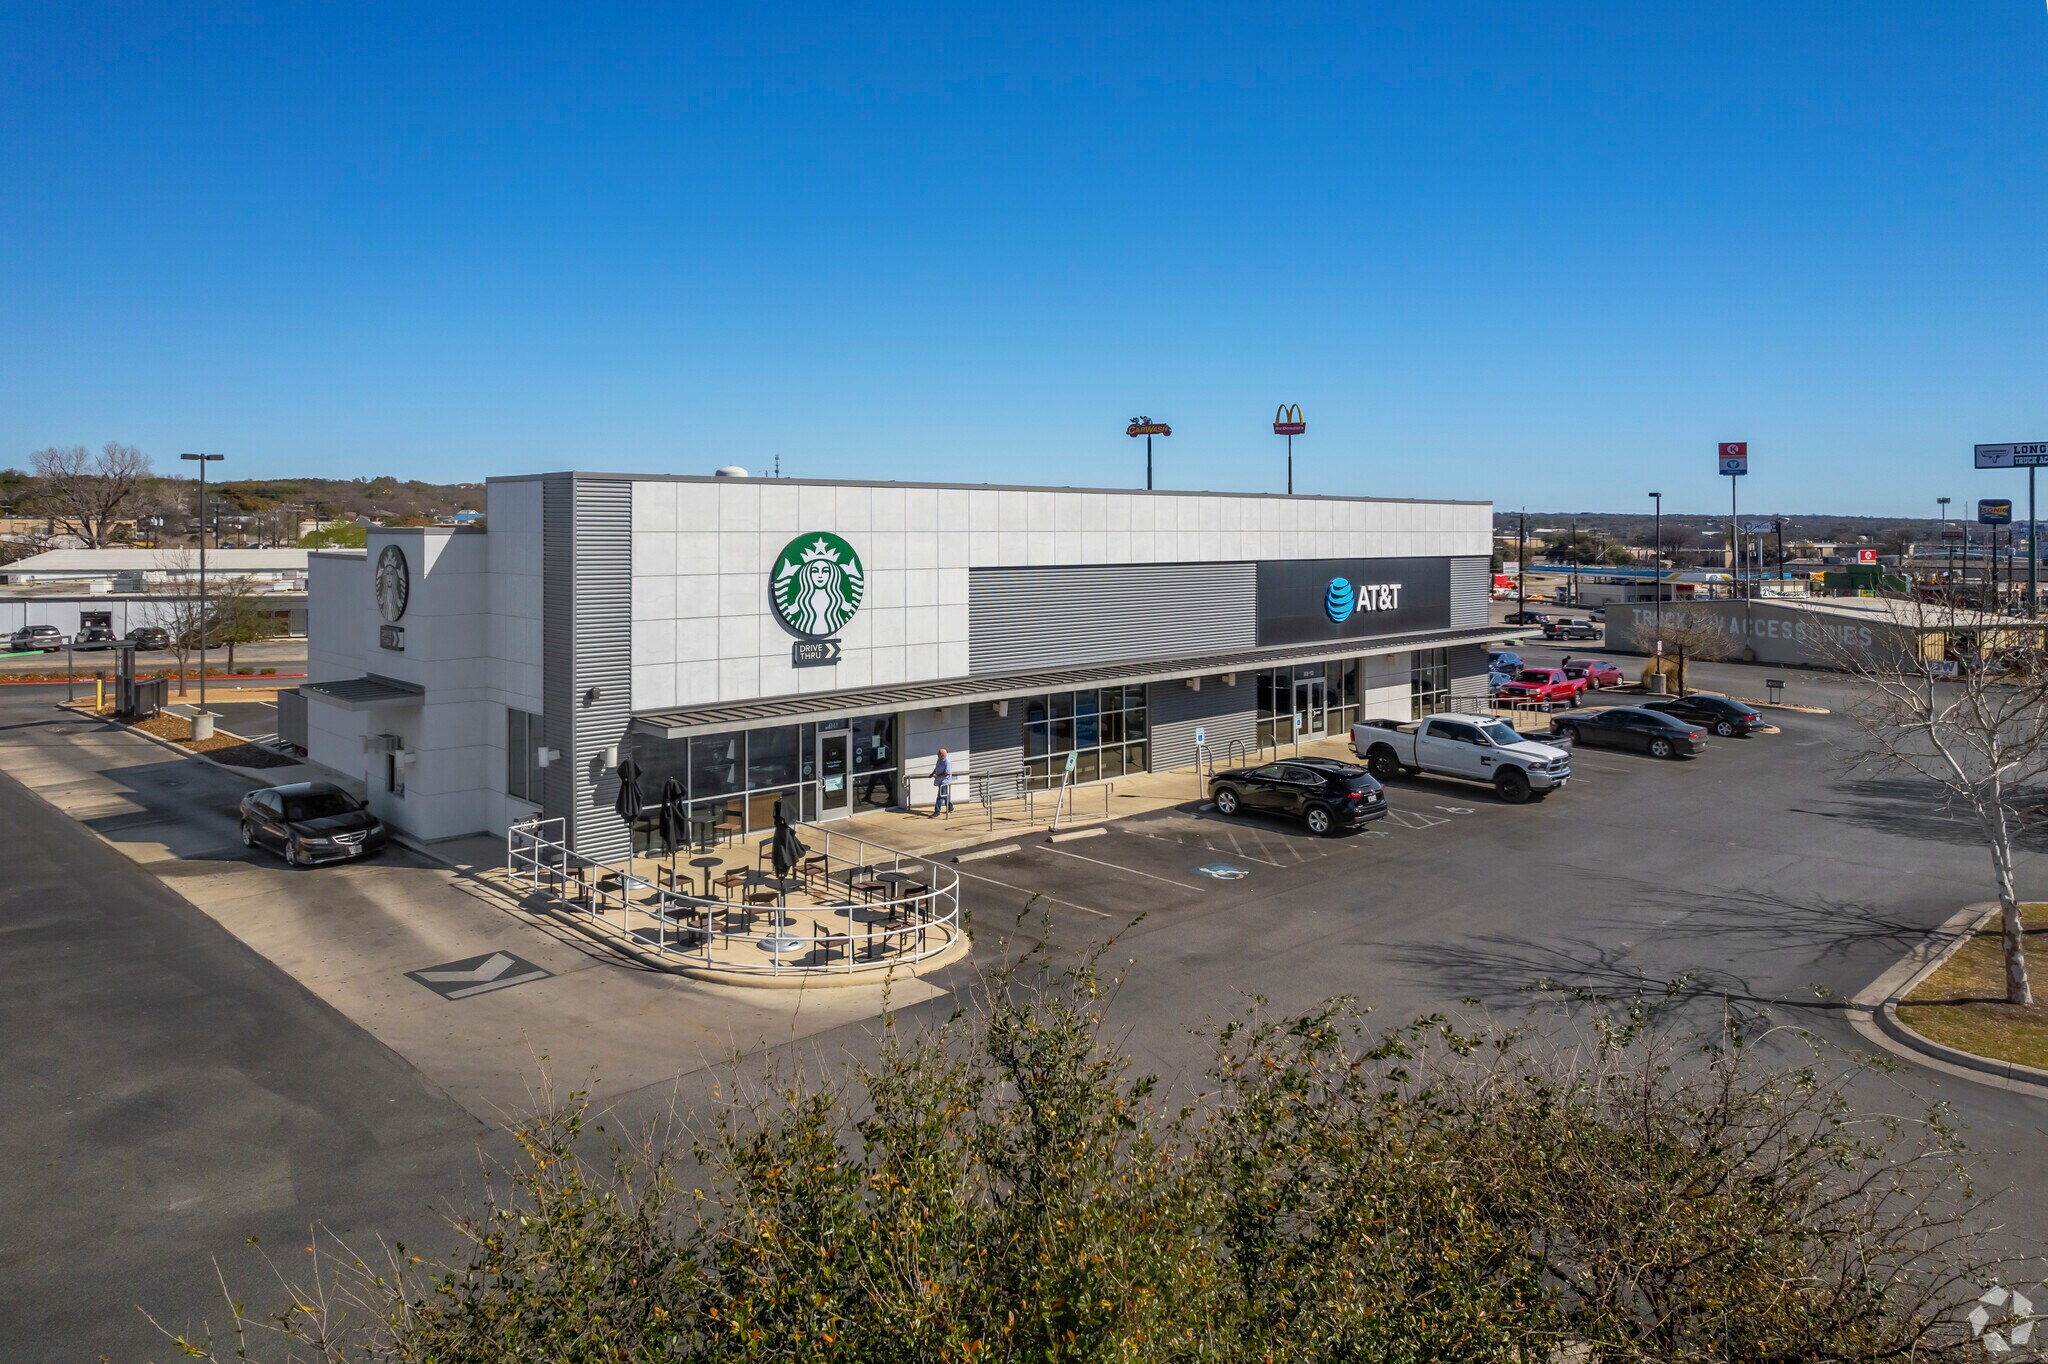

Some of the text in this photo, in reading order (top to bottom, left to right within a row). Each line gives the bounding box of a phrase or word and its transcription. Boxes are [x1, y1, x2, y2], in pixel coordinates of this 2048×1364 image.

[2014, 445, 2048, 454] LONG
[2015, 456, 2037, 464] TRUCK
[1356, 584, 1402, 612] AT&T
[1729, 616, 1873, 647] ACCESSORIES
[799, 644, 823, 653] DRIVE
[799, 652, 822, 660] THRU
